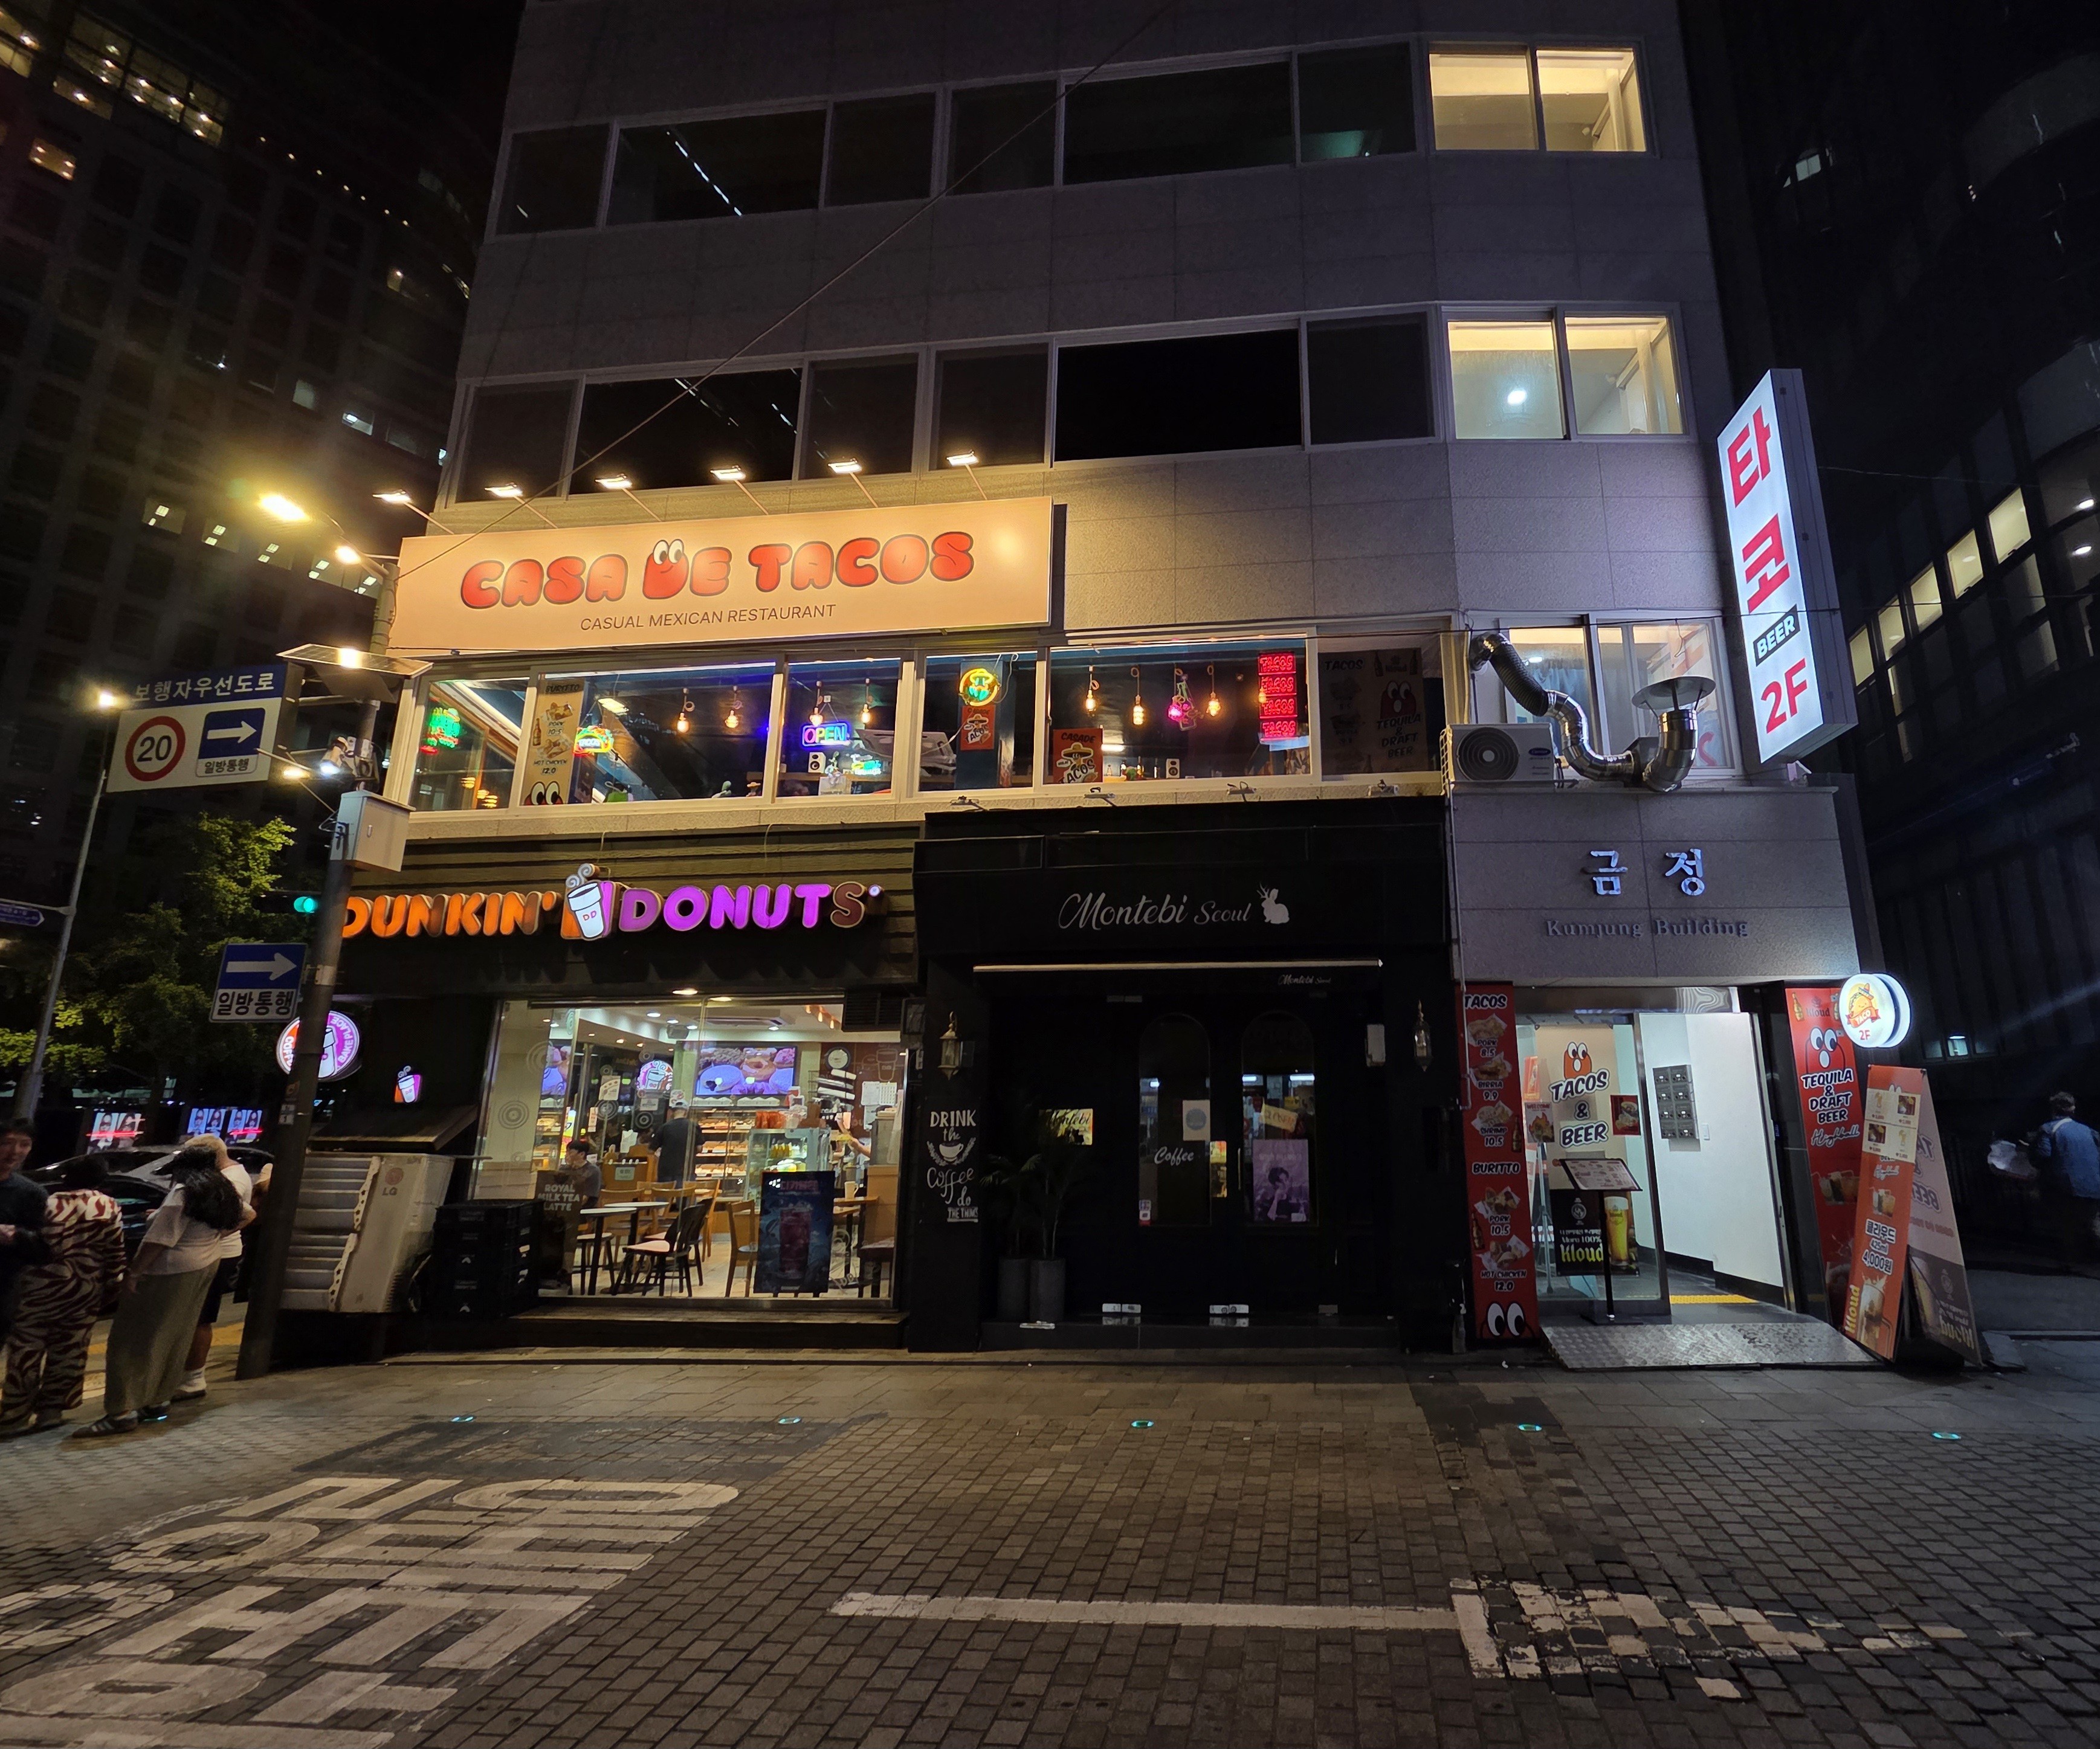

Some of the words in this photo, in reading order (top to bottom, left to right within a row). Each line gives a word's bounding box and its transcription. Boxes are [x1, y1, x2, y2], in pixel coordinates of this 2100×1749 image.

[1728, 407, 1790, 614] 타코
[460, 553, 628, 609] CASA
[642, 540, 732, 599] DE
[748, 531, 974, 592] TACOS
[580, 614, 644, 631] CASUAL
[648, 610, 723, 627] MEXICAN
[727, 604, 836, 622] RESTAURANT
[1757, 614, 1795, 659] BEER
[1259, 655, 1293, 672] TACOS
[1325, 659, 1363, 671] TACOS
[133, 672, 274, 702] 보행자우선도로
[1261, 677, 1294, 693] TACOS
[1760, 658, 1808, 733] 2F
[1261, 699, 1294, 715] TACOS
[1262, 721, 1296, 737] TACOS
[1377, 713, 1421, 730] TEQUILA
[578, 738, 601, 747] TACOS
[804, 726, 845, 743] OPEN
[1061, 732, 1096, 744] CASADE
[1381, 733, 1419, 747] DRAFT
[137, 735, 172, 762] 20
[1388, 746, 1413, 758] BEER
[204, 758, 249, 774] 일방통행
[619, 881, 868, 932] DONUTS
[1058, 892, 1189, 930] Montebi
[583, 910, 597, 921] DD
[1546, 920, 1642, 937] Kumjung
[1655, 919, 1748, 936] Building
[218, 990, 294, 1016] 일방통행
[1464, 994, 1508, 1009] TACOS
[1855, 1010, 1872, 1026] TACO
[332, 1016, 354, 1040] PLACE
[1859, 1029, 1871, 1040] 2F
[338, 1039, 354, 1064] BAKE
[1481, 1048, 1496, 1057] 8.5
[1551, 1071, 1607, 1101] TACOS
[1802, 1070, 1853, 1089] TEQUILA
[1484, 1091, 1498, 1100] 9.9
[1825, 1086, 1833, 1096] &
[1811, 1094, 1851, 1110] DRAFT
[930, 1109, 977, 1127] DRINK
[1576, 1103, 1588, 1118] &
[1818, 1110, 1847, 1124] BEER
[943, 1127, 961, 1141] the
[1485, 1137, 1504, 1145] 10.5
[1562, 1124, 1606, 1146] BEER
[1154, 1146, 1195, 1166] Coffee
[1473, 1163, 1520, 1173] BURITTO
[382, 1187, 398, 1196] LG
[544, 1184, 575, 1193] ROYAL
[926, 1167, 974, 1204] Coffee
[538, 1193, 561, 1202] MILK
[563, 1193, 580, 1202] TEA
[957, 1185, 972, 1206] do
[544, 1203, 572, 1211] LATTE
[1491, 1226, 1510, 1234] 10.5
[1867, 1220, 1896, 1243] 클라우드
[1560, 1243, 1604, 1263] Kloud
[1862, 1250, 1893, 1275] 4,000원
[1494, 1281, 1514, 1291] 12.0
[1845, 1284, 1860, 1334] Kloud
